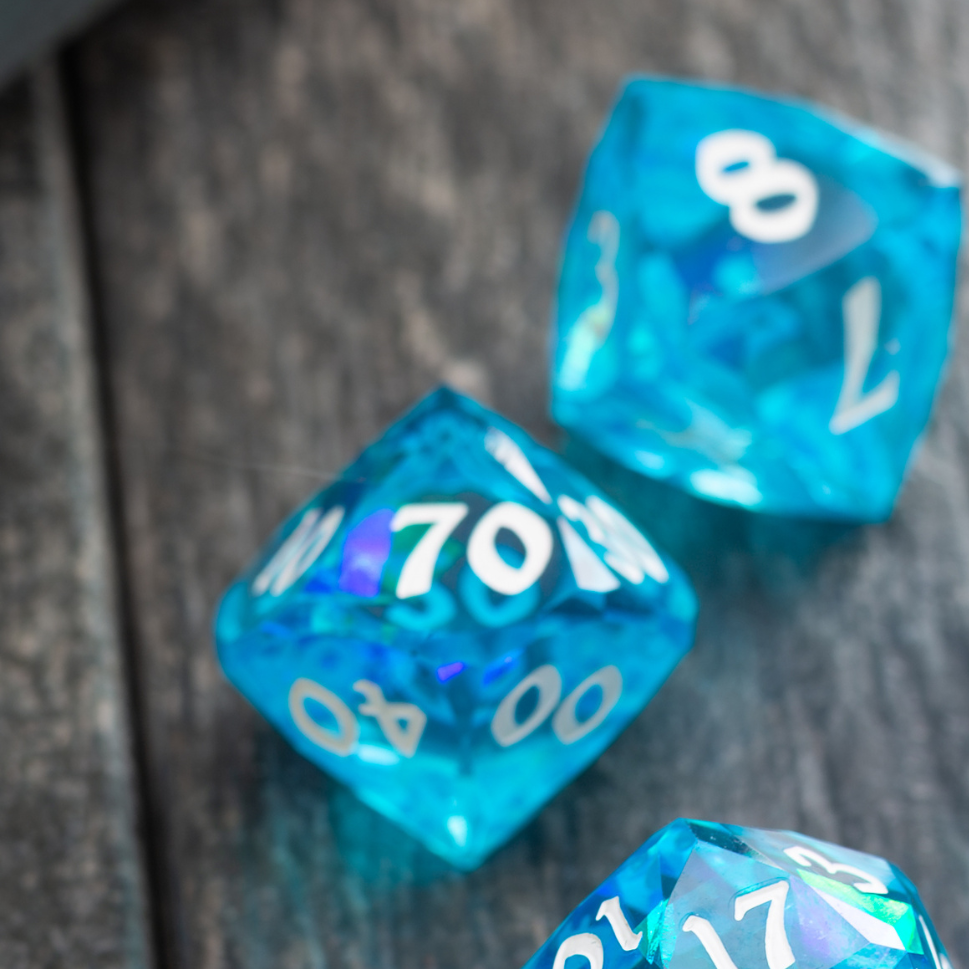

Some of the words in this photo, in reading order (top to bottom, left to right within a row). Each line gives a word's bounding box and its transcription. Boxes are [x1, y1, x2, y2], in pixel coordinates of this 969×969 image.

[695, 129, 820, 244] 8
[829, 276, 900, 435] 7
[391, 501, 553, 599] 70
[288, 678, 427, 758] 40
[491, 665, 623, 747] 00
[783, 845, 889, 895] 3
